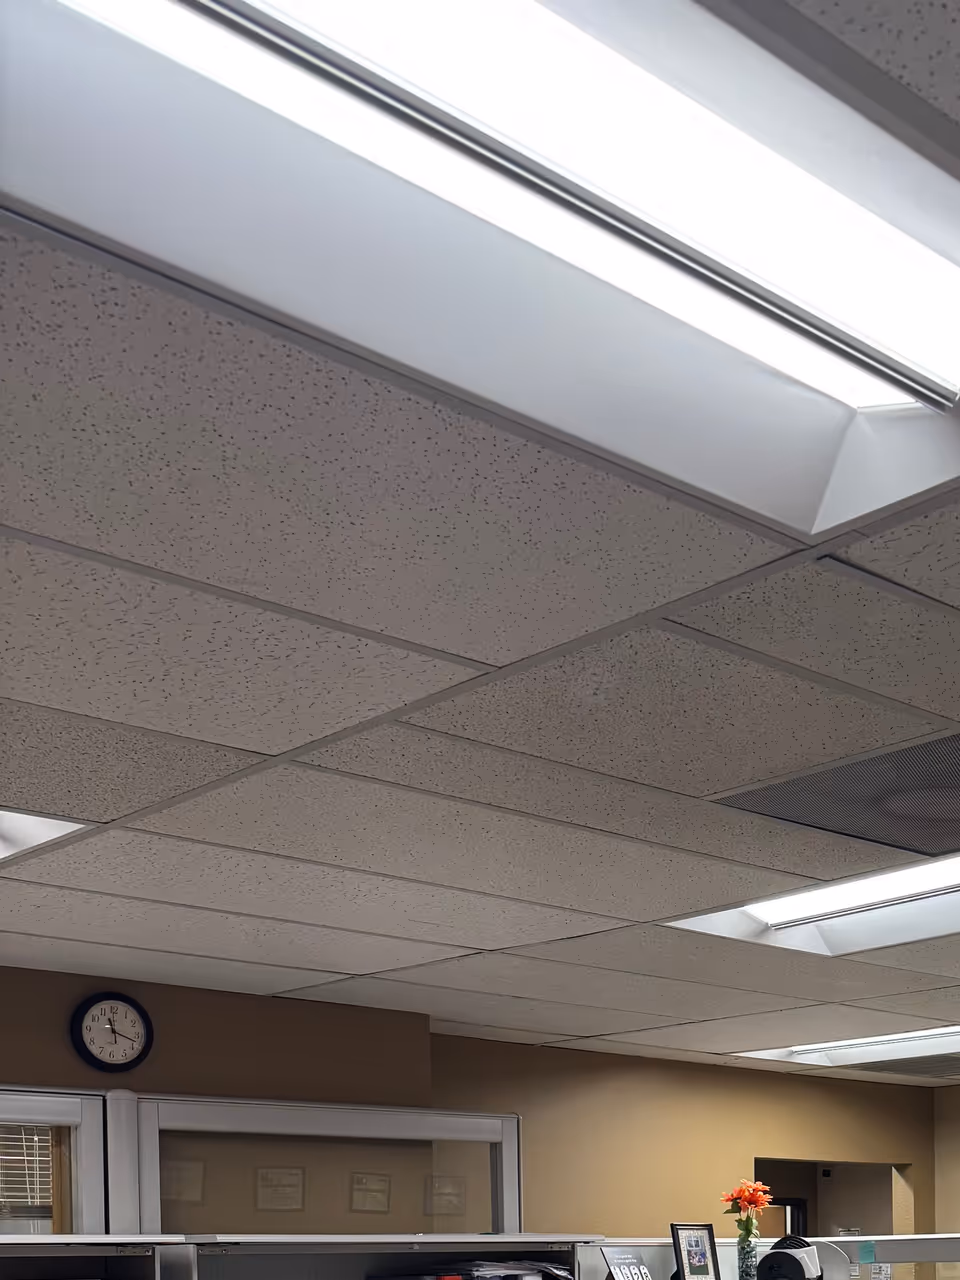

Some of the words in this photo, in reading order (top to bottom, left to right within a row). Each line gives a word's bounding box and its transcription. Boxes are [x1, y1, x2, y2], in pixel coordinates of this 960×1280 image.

[110, 1006, 119, 1014] 12
[92, 1014, 100, 1023] 10
[131, 1020, 137, 1028] 2
[85, 1025, 92, 1033] 9
[99, 1046, 104, 1055] 7
[108, 1050, 115, 1058] 6
